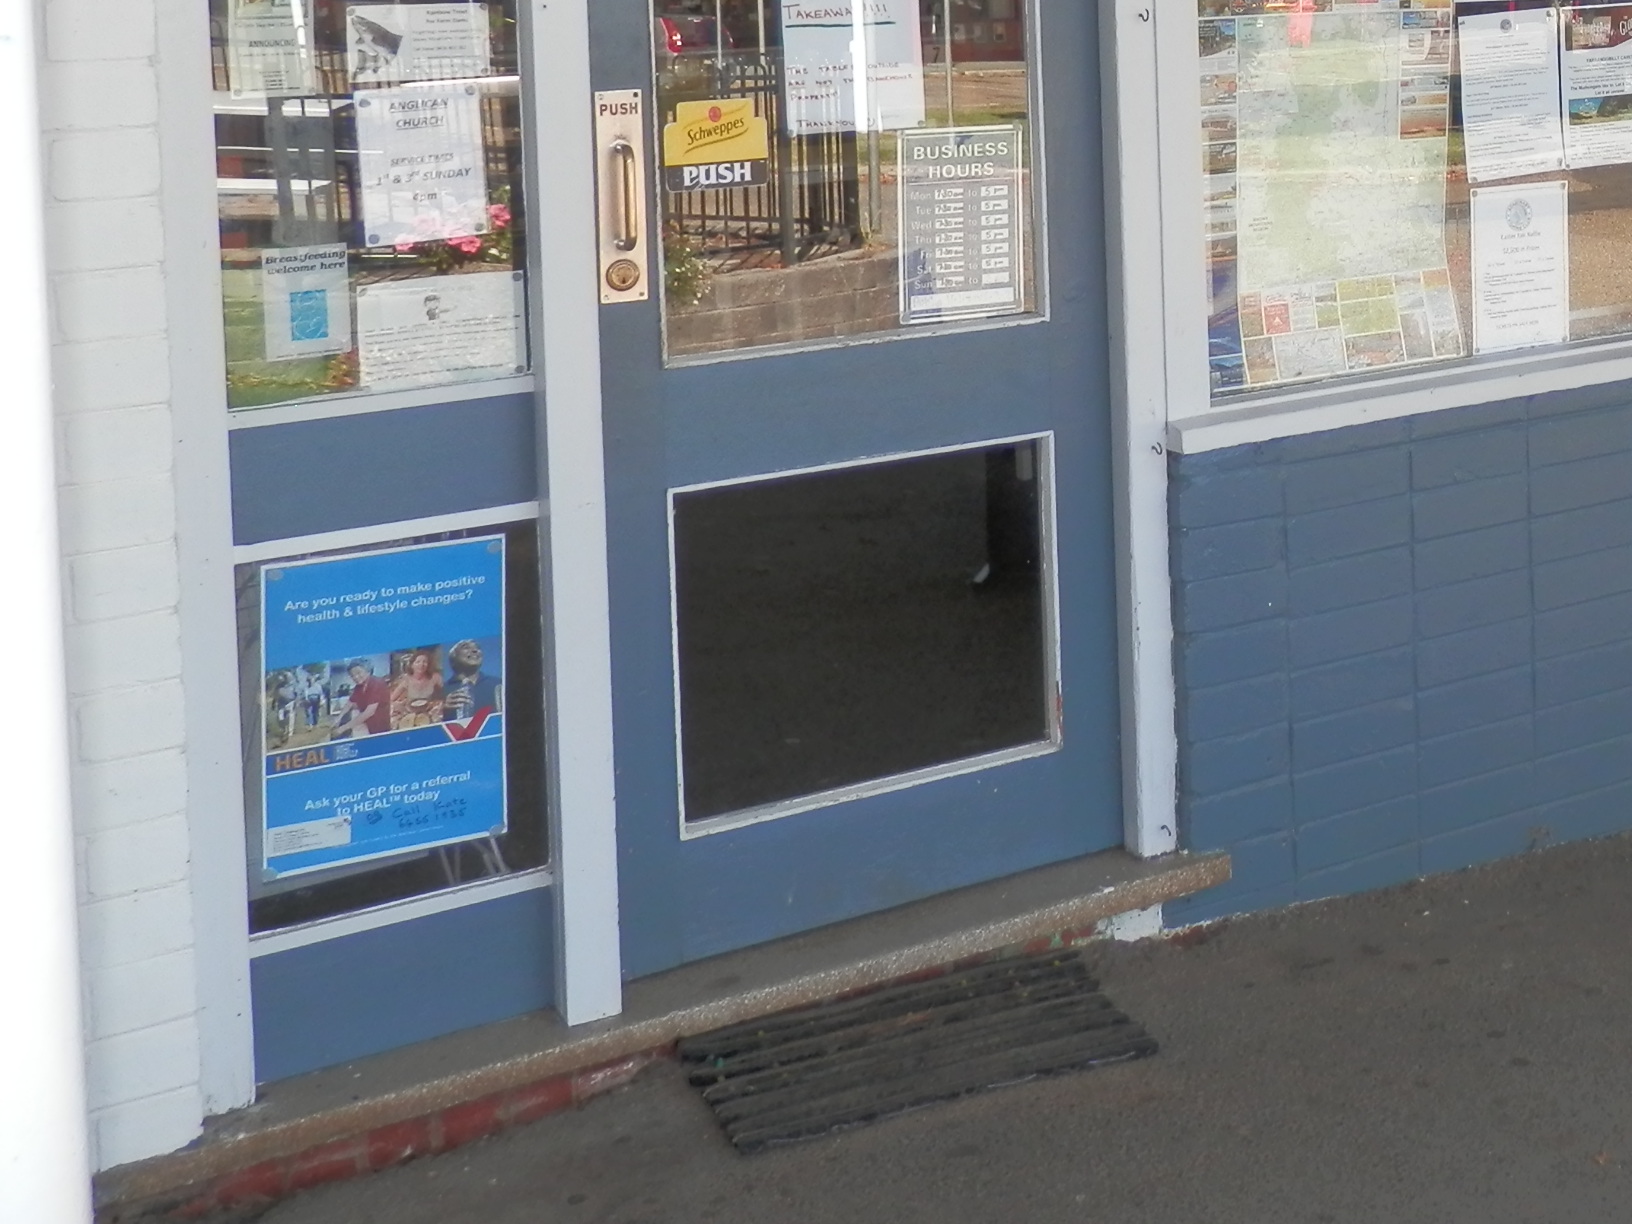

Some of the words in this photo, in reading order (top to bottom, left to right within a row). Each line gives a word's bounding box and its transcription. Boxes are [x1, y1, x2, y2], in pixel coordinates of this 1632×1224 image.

[389, 97, 449, 111] ANGLICAN
[599, 102, 639, 117] PUSH
[396, 115, 444, 128] CHURCH
[686, 117, 745, 146] Schweppes
[913, 141, 1009, 160] BUSINESS
[422, 167, 472, 182] SUNDAY
[683, 161, 752, 187] PUSH
[928, 161, 995, 179] HOURS
[412, 190, 438, 203] 4pm
[265, 250, 346, 265] Breastfeeding
[267, 264, 317, 275] welcome
[319, 261, 346, 270] here
[284, 599, 309, 612] Are
[312, 596, 337, 610] you
[340, 588, 379, 604] ready
[379, 587, 395, 597] to
[397, 582, 432, 595] make
[435, 574, 486, 592] positive
[297, 607, 340, 624] health
[343, 606, 354, 617] &
[357, 598, 408, 616] lifestyle
[411, 588, 474, 608] changes?
[275, 748, 330, 772] HEAL
[304, 797, 330, 811] Ask
[333, 790, 364, 808] your
[366, 786, 387, 799] GP
[388, 782, 409, 795] for
[410, 782, 420, 791] a
[422, 771, 471, 788] referral
[336, 807, 350, 817] to
[403, 789, 441, 805] today
